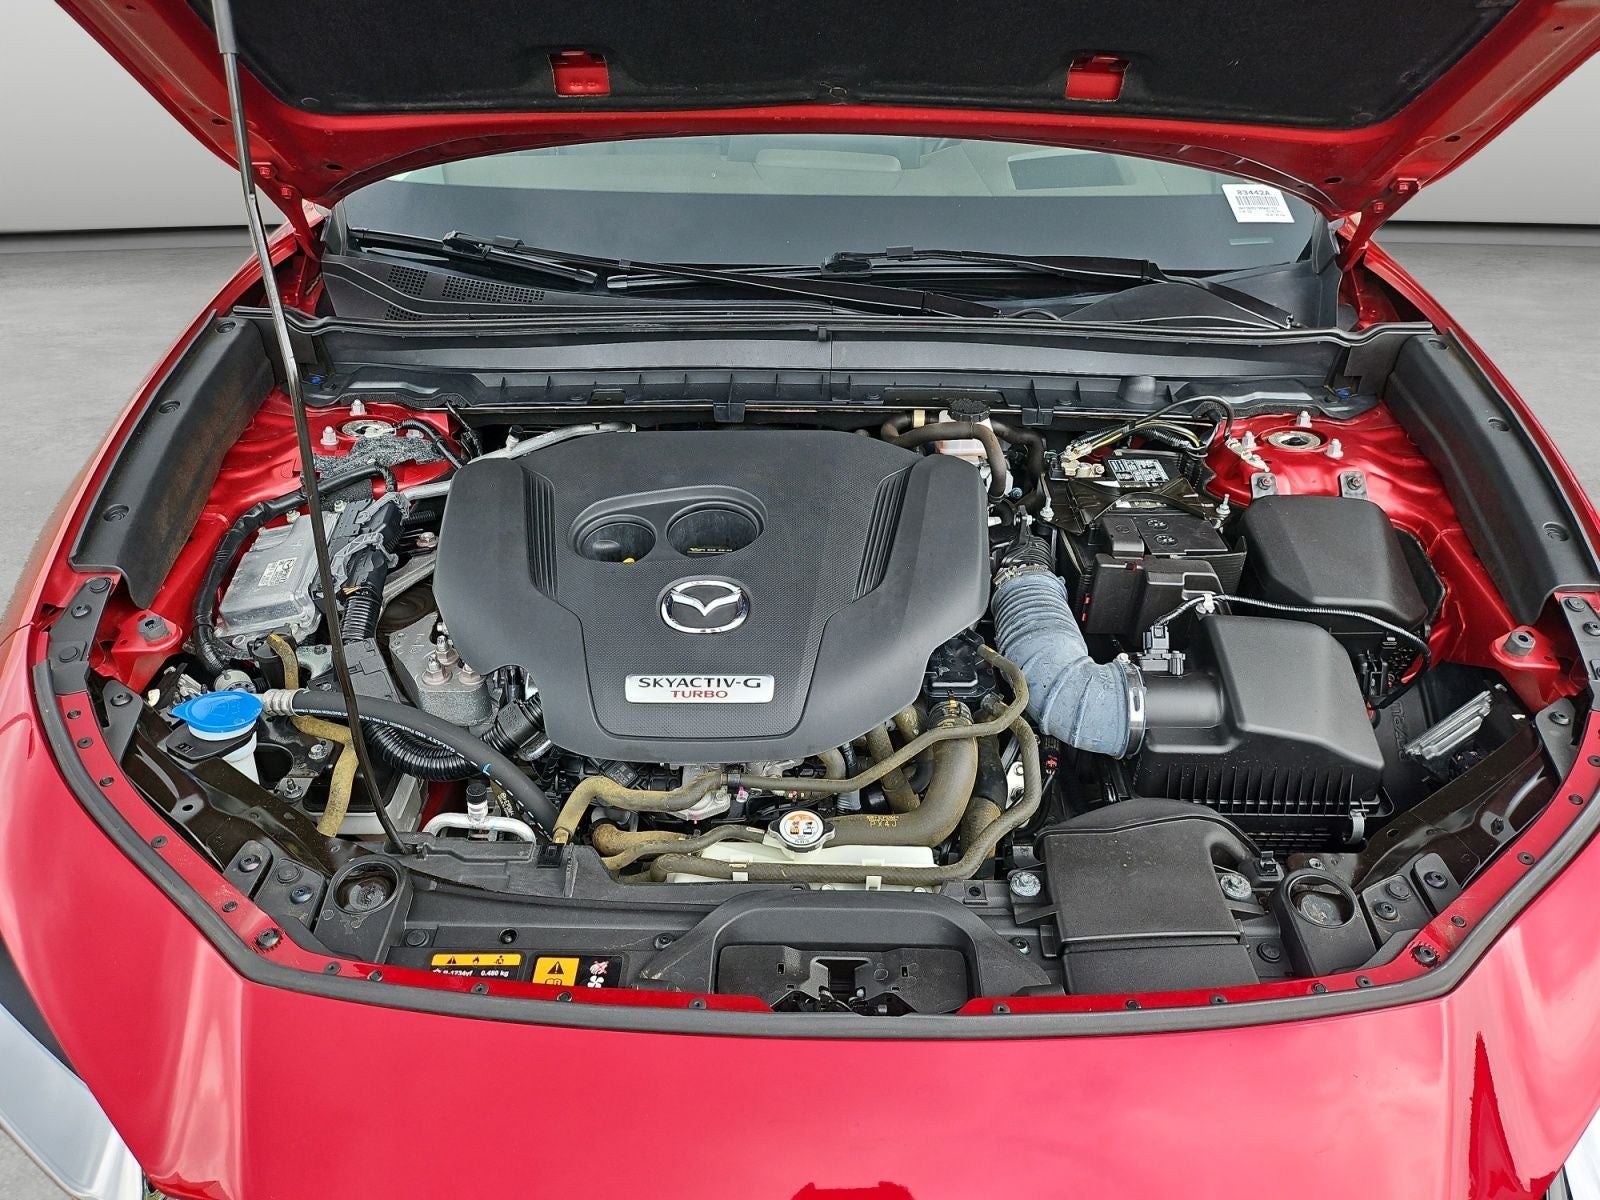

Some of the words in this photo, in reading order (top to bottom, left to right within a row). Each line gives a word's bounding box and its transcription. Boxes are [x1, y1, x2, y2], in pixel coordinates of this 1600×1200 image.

[638, 677, 761, 688] SKYACTIV-G
[670, 690, 728, 698] TURBO
[500, 969, 509, 977] kg
